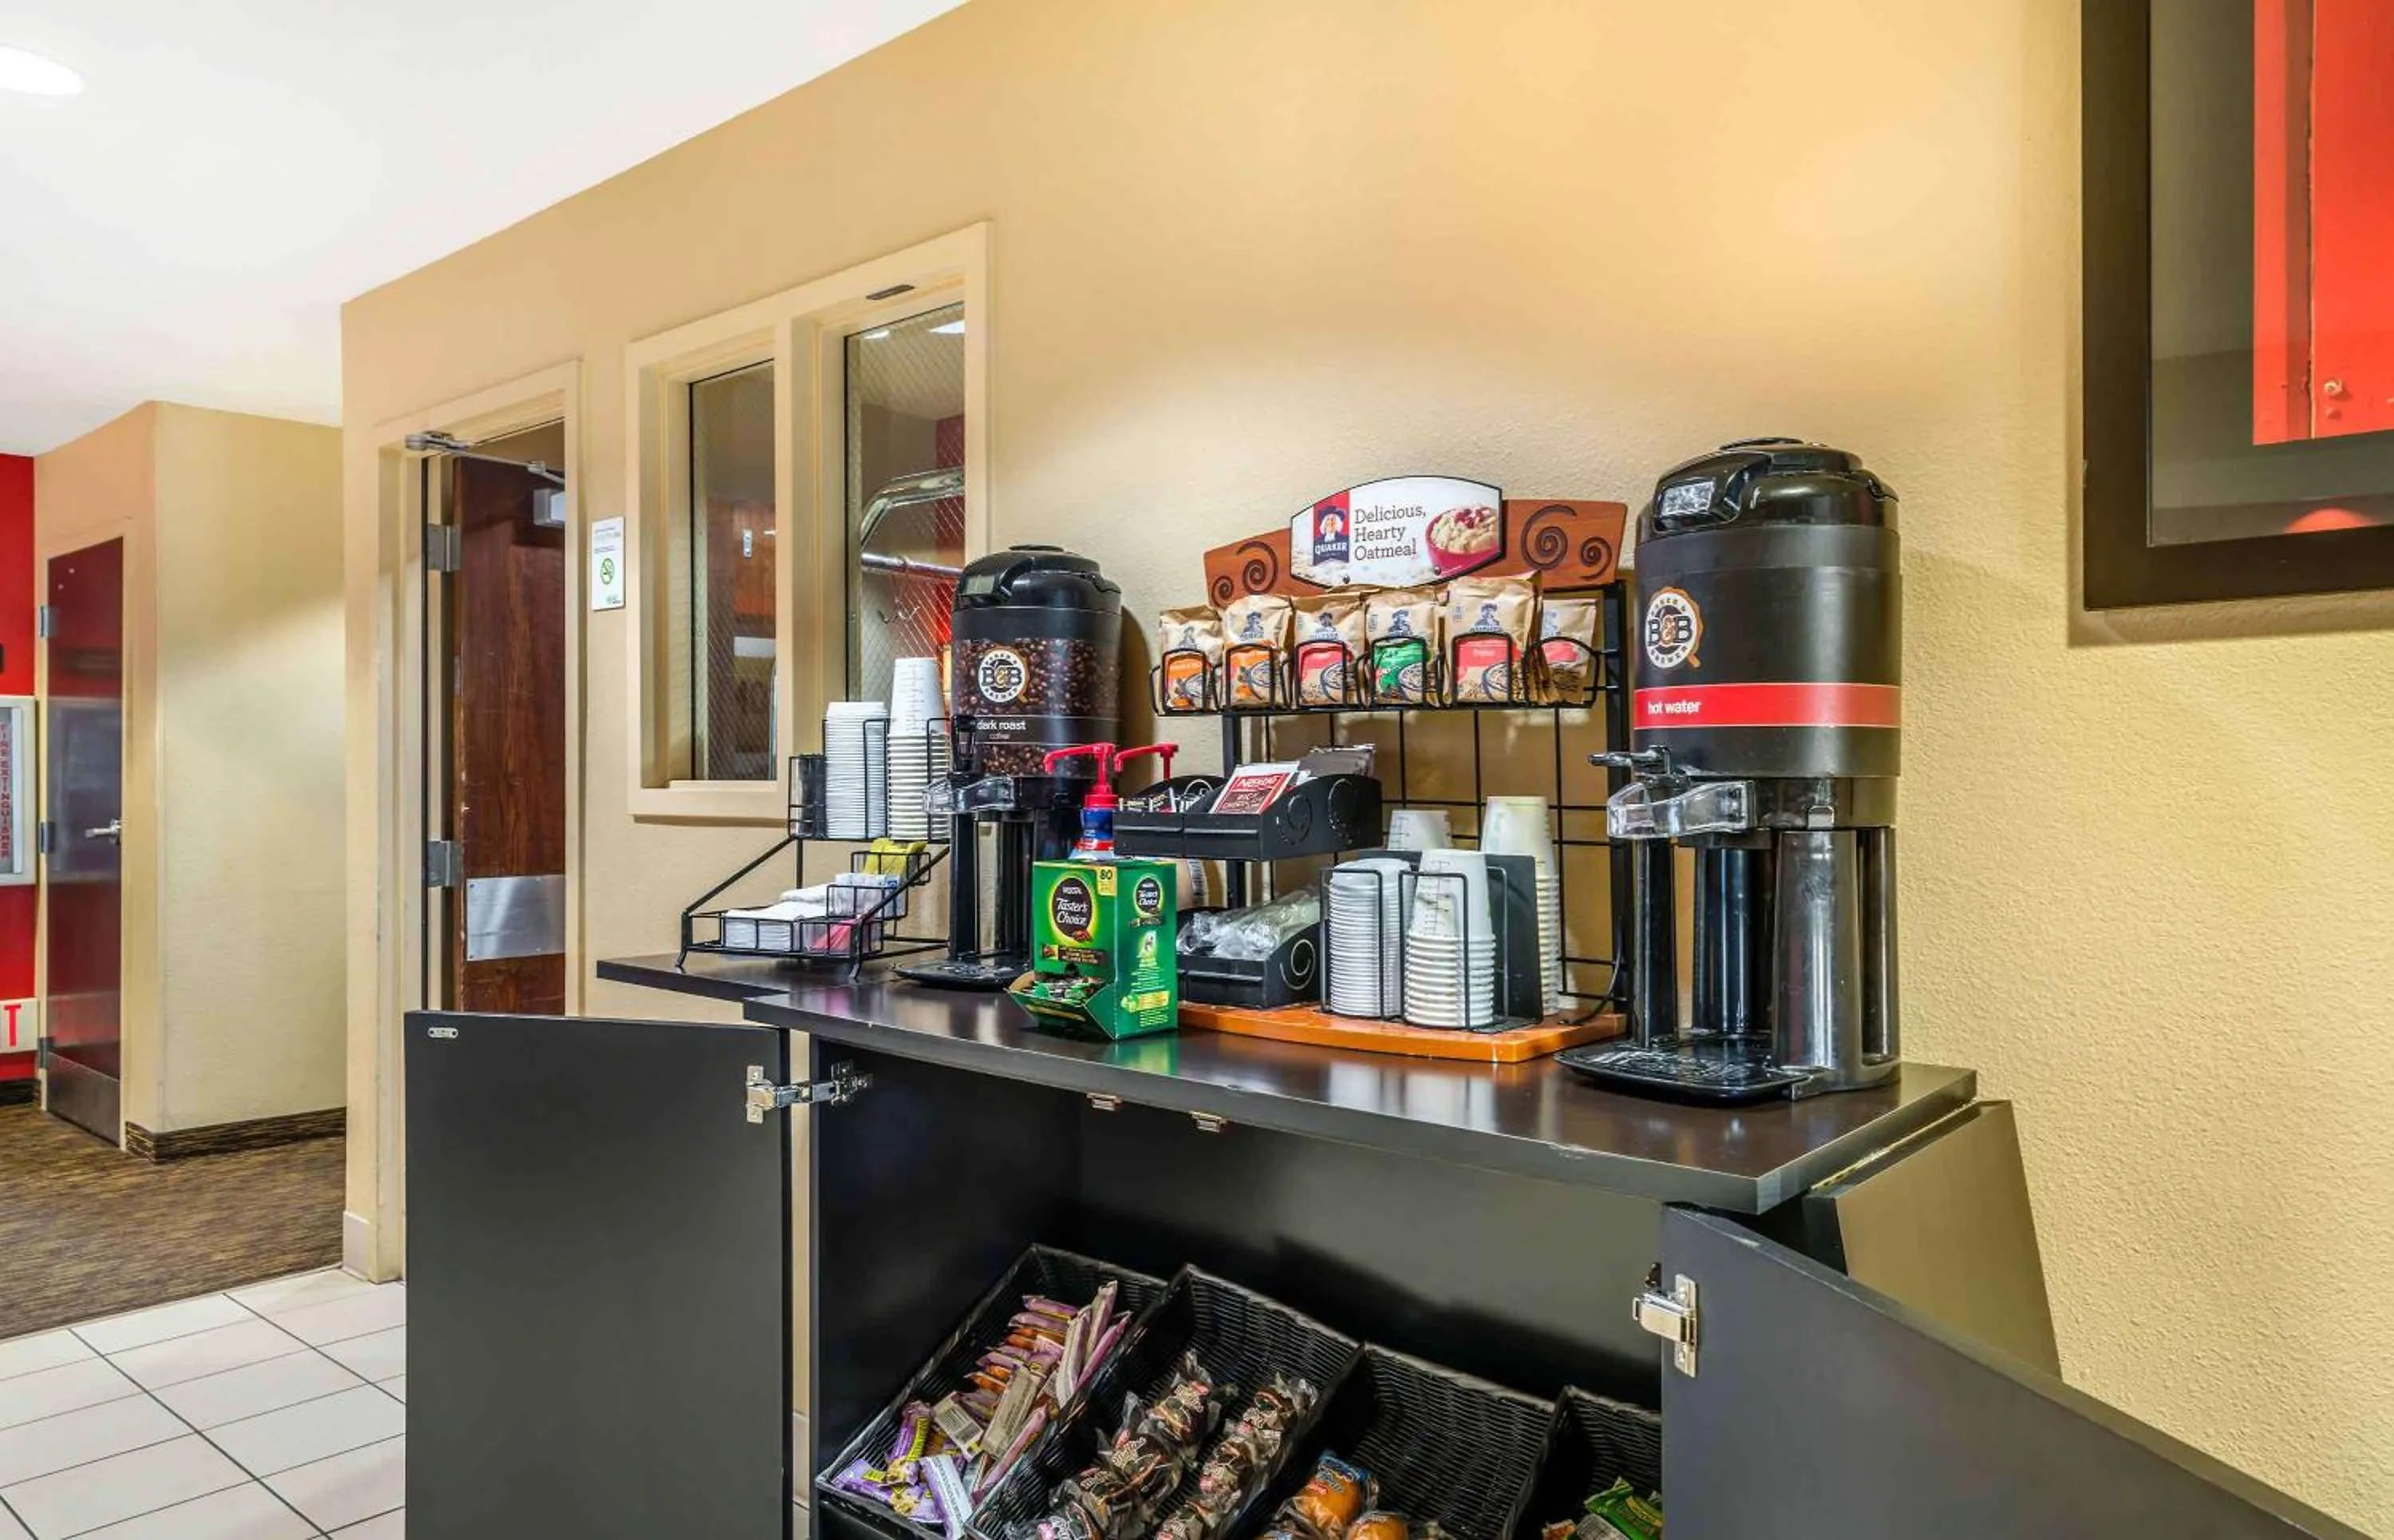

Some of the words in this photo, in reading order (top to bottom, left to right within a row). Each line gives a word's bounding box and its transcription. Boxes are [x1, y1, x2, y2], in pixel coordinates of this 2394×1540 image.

[1354, 505, 1426, 524] Delicious,
[1354, 525, 1406, 543] Hearty
[1314, 542, 1348, 556] QUAKER
[1354, 538, 1417, 560] Oatmeal
[1648, 701, 1664, 715] hot
[1665, 699, 1701, 714] water
[976, 719, 998, 731] dark
[999, 720, 1027, 731] roast
[1, 759, 11, 860] EXTINGUISHER
[1100, 869, 1113, 879] 80
[1057, 898, 1089, 913] Taster's
[1057, 911, 1088, 926] Choice
